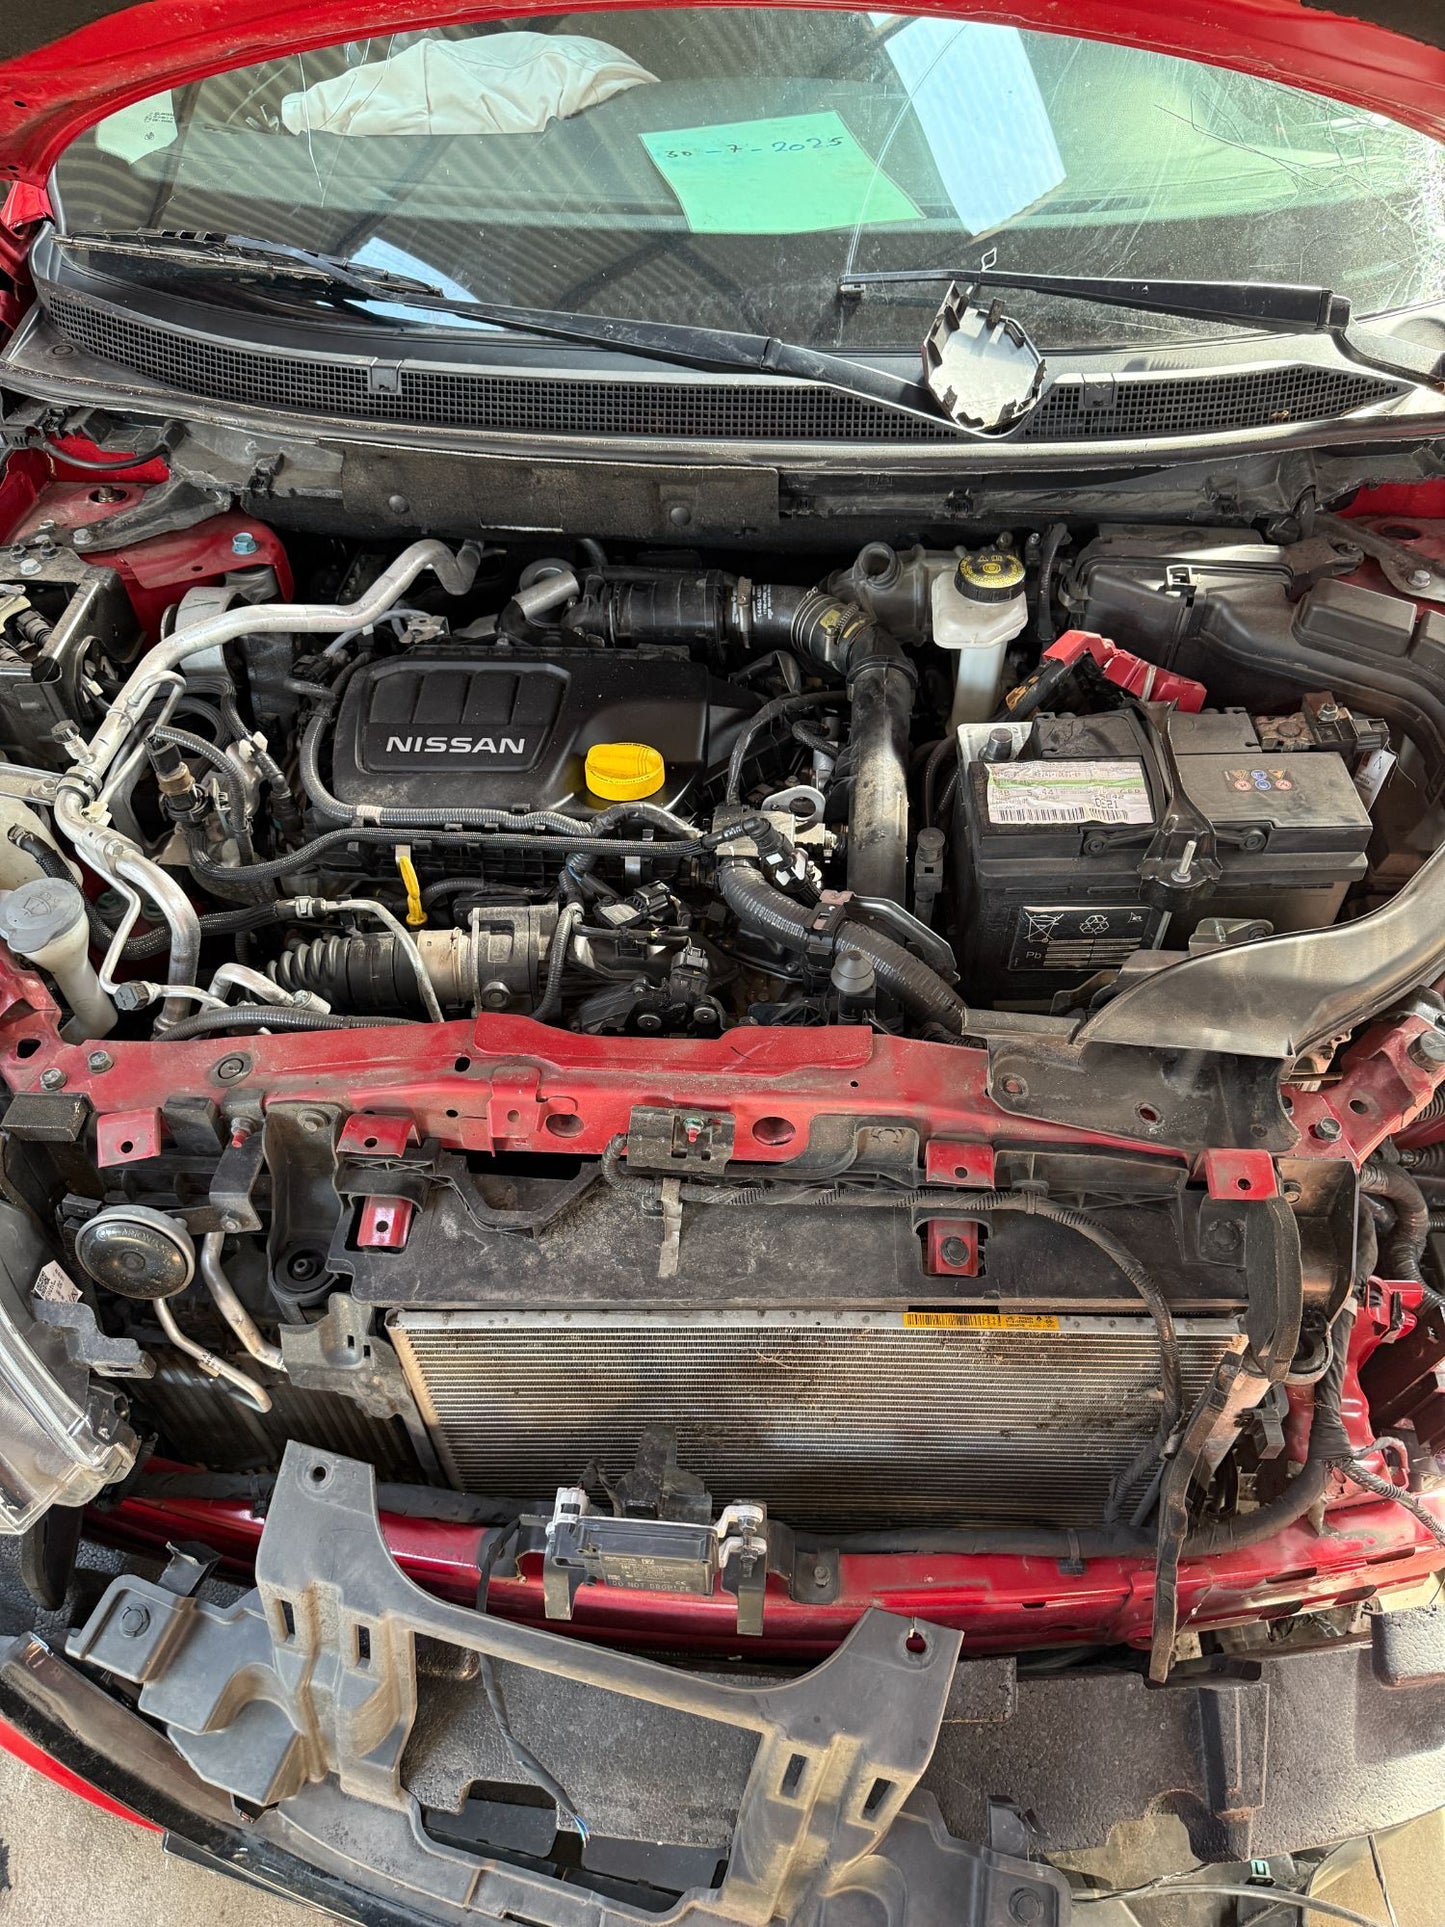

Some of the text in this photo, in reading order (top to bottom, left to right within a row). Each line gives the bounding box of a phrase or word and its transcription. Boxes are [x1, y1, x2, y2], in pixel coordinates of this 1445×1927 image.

[727, 143, 742, 153] 7
[771, 137, 845, 153] 2025
[385, 736, 526, 754] NISSAN
[1025, 951, 1042, 960] Pb
[627, 1581, 645, 1589] NOT
